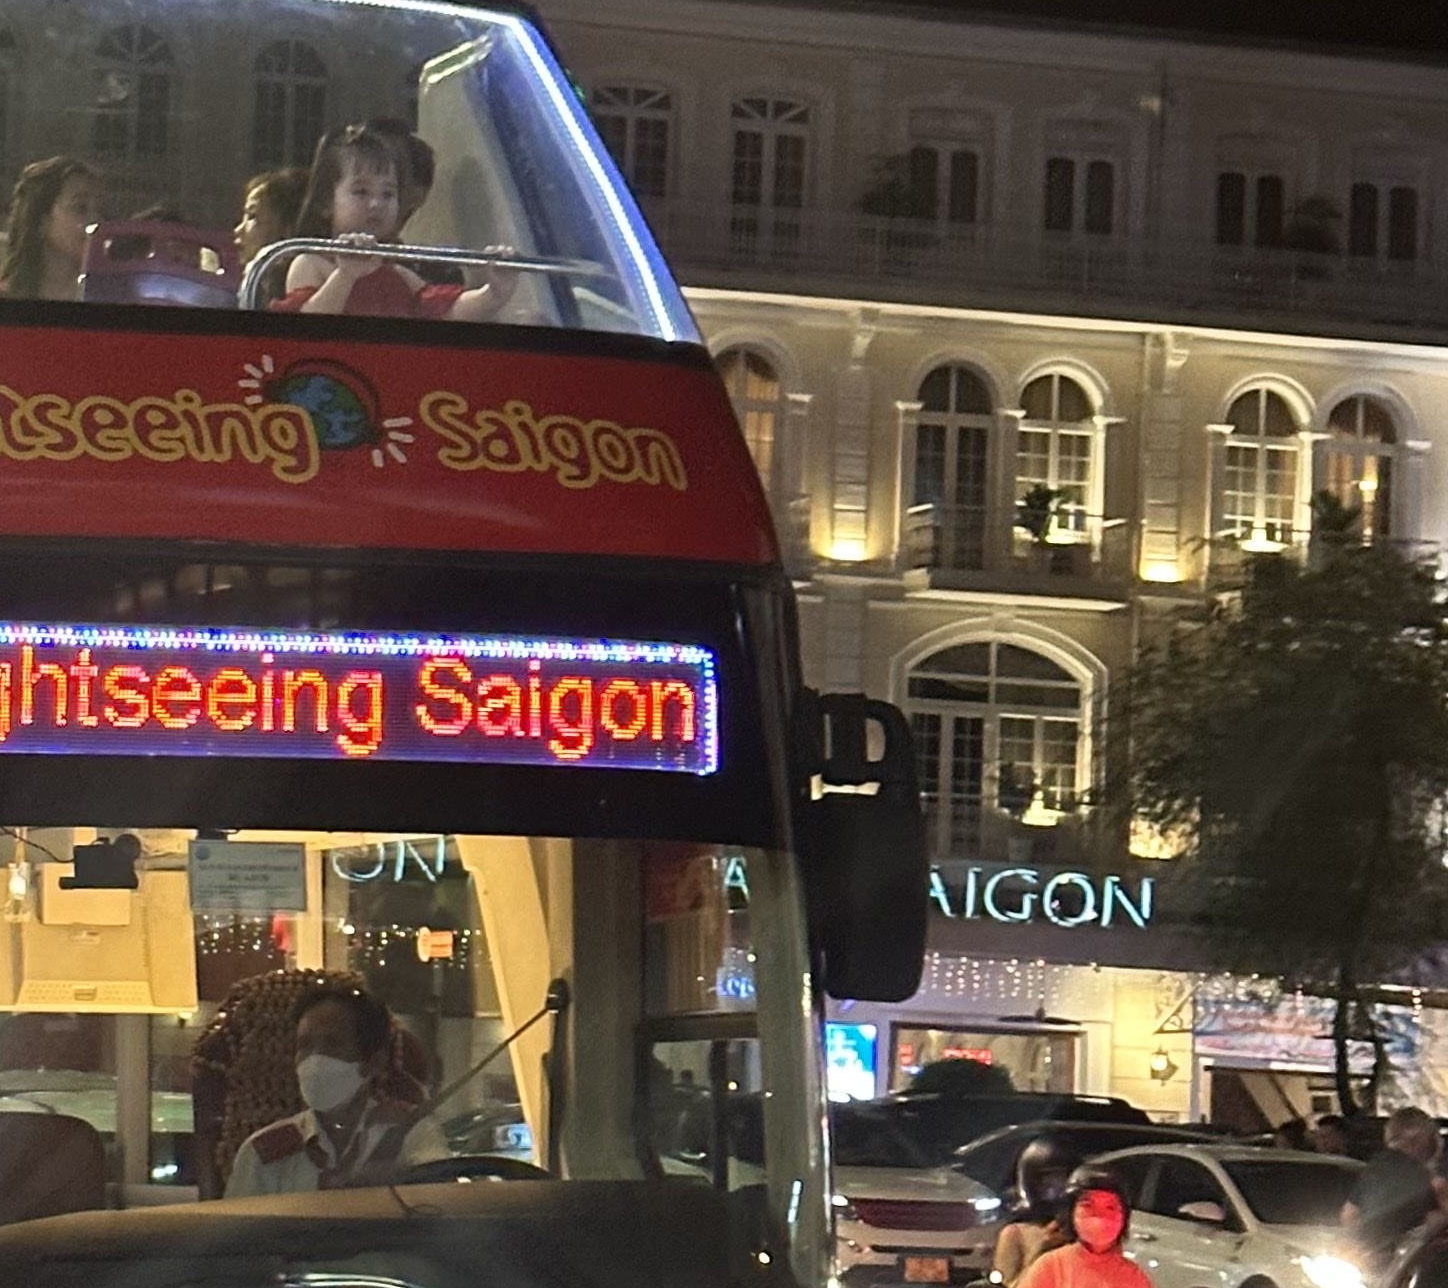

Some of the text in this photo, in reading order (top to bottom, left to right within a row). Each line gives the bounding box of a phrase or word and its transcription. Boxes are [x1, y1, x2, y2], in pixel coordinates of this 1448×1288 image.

[419, 390, 688, 492] Saigon
[415, 655, 696, 761] Saigon
[929, 864, 1155, 929] AIGON
